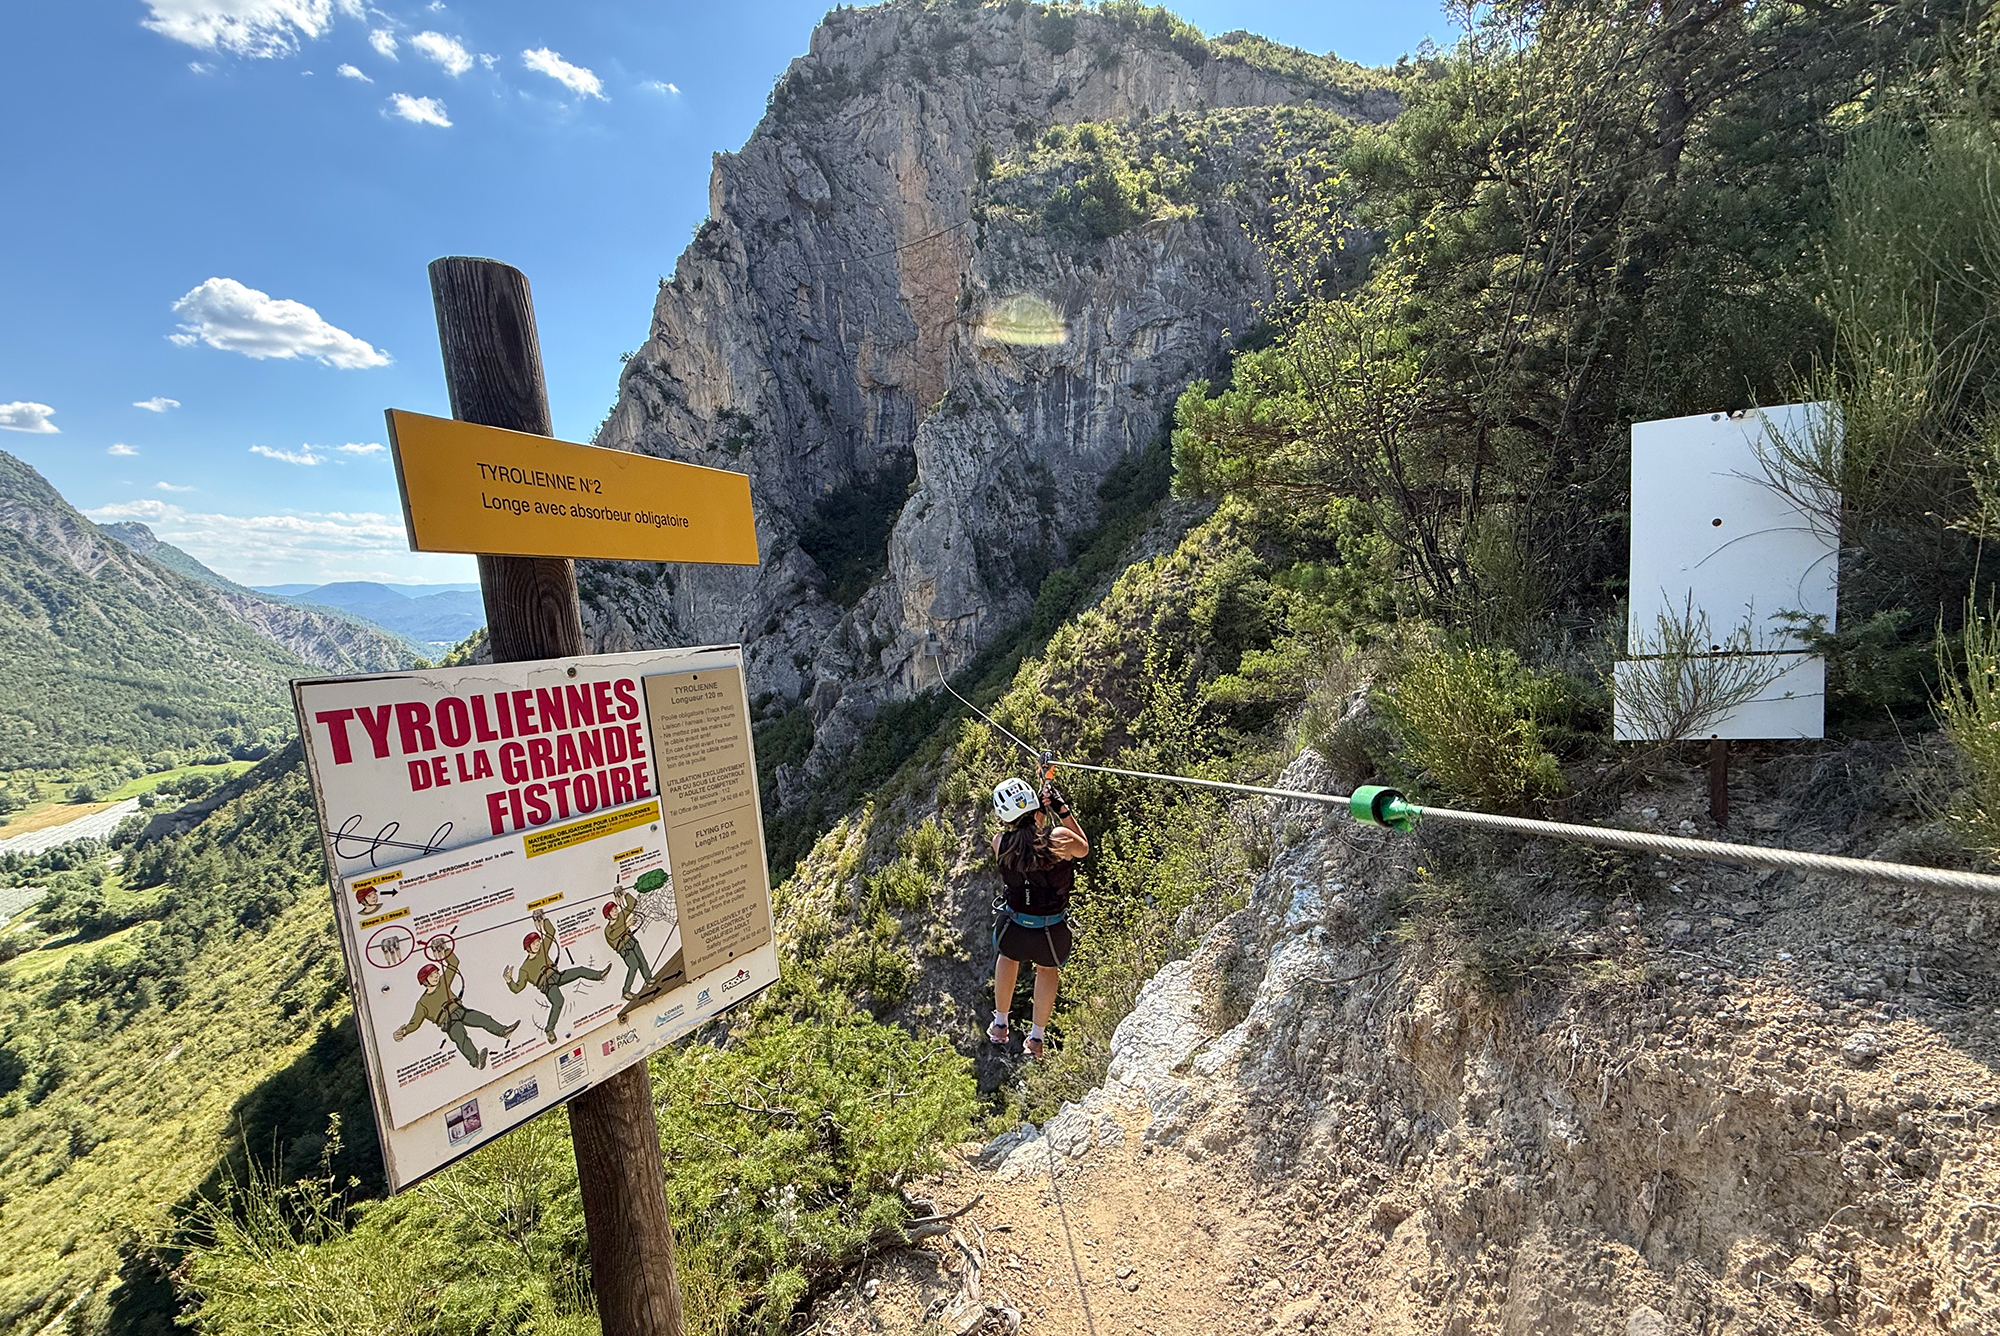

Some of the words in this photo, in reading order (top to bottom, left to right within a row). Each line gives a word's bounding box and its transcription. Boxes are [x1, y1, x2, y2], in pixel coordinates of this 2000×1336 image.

[477, 462, 576, 491] TYROLIENNE
[579, 477, 602, 494] N°2
[482, 492, 530, 516] Longe
[534, 501, 566, 516] avec
[570, 503, 631, 523] absorbeur
[634, 511, 689, 529] obligatoire
[674, 682, 718, 694] TYROLIENNE
[671, 694, 703, 704] Longueur
[315, 679, 639, 765] TYROLIENNES
[678, 710, 704, 718] obligatoire
[407, 756, 451, 791] DE
[456, 750, 493, 785] LA
[499, 722, 646, 785] GRANDE
[666, 773, 702, 787] UTILISATION
[702, 762, 745, 778] EXCLUSIVEMENT
[692, 779, 708, 788] SOUS
[486, 762, 651, 835] FISTOIRE
[678, 786, 706, 799] D'ADULTE
[528, 833, 556, 844] MATÉRIEL
[557, 823, 592, 836] OBLIGATOIRE
[618, 807, 650, 819] TYROLIENNES
[696, 825, 720, 838] FLYING
[720, 820, 734, 830] FOX
[695, 835, 718, 848] Lenght
[719, 831, 729, 840] 120
[681, 859, 696, 868] Pulley
[682, 863, 710, 876] Connection
[702, 877, 710, 886] put
[718, 869, 733, 878] hands
[732, 879, 746, 888] before
[699, 884, 715, 893] before
[694, 925, 705, 935] USE
[706, 910, 741, 930] EXCLUSIVELY
[742, 906, 748, 914] BY
[700, 926, 720, 939] UNDER
[720, 916, 745, 930] CONTROL
[734, 919, 750, 931] ADULT
